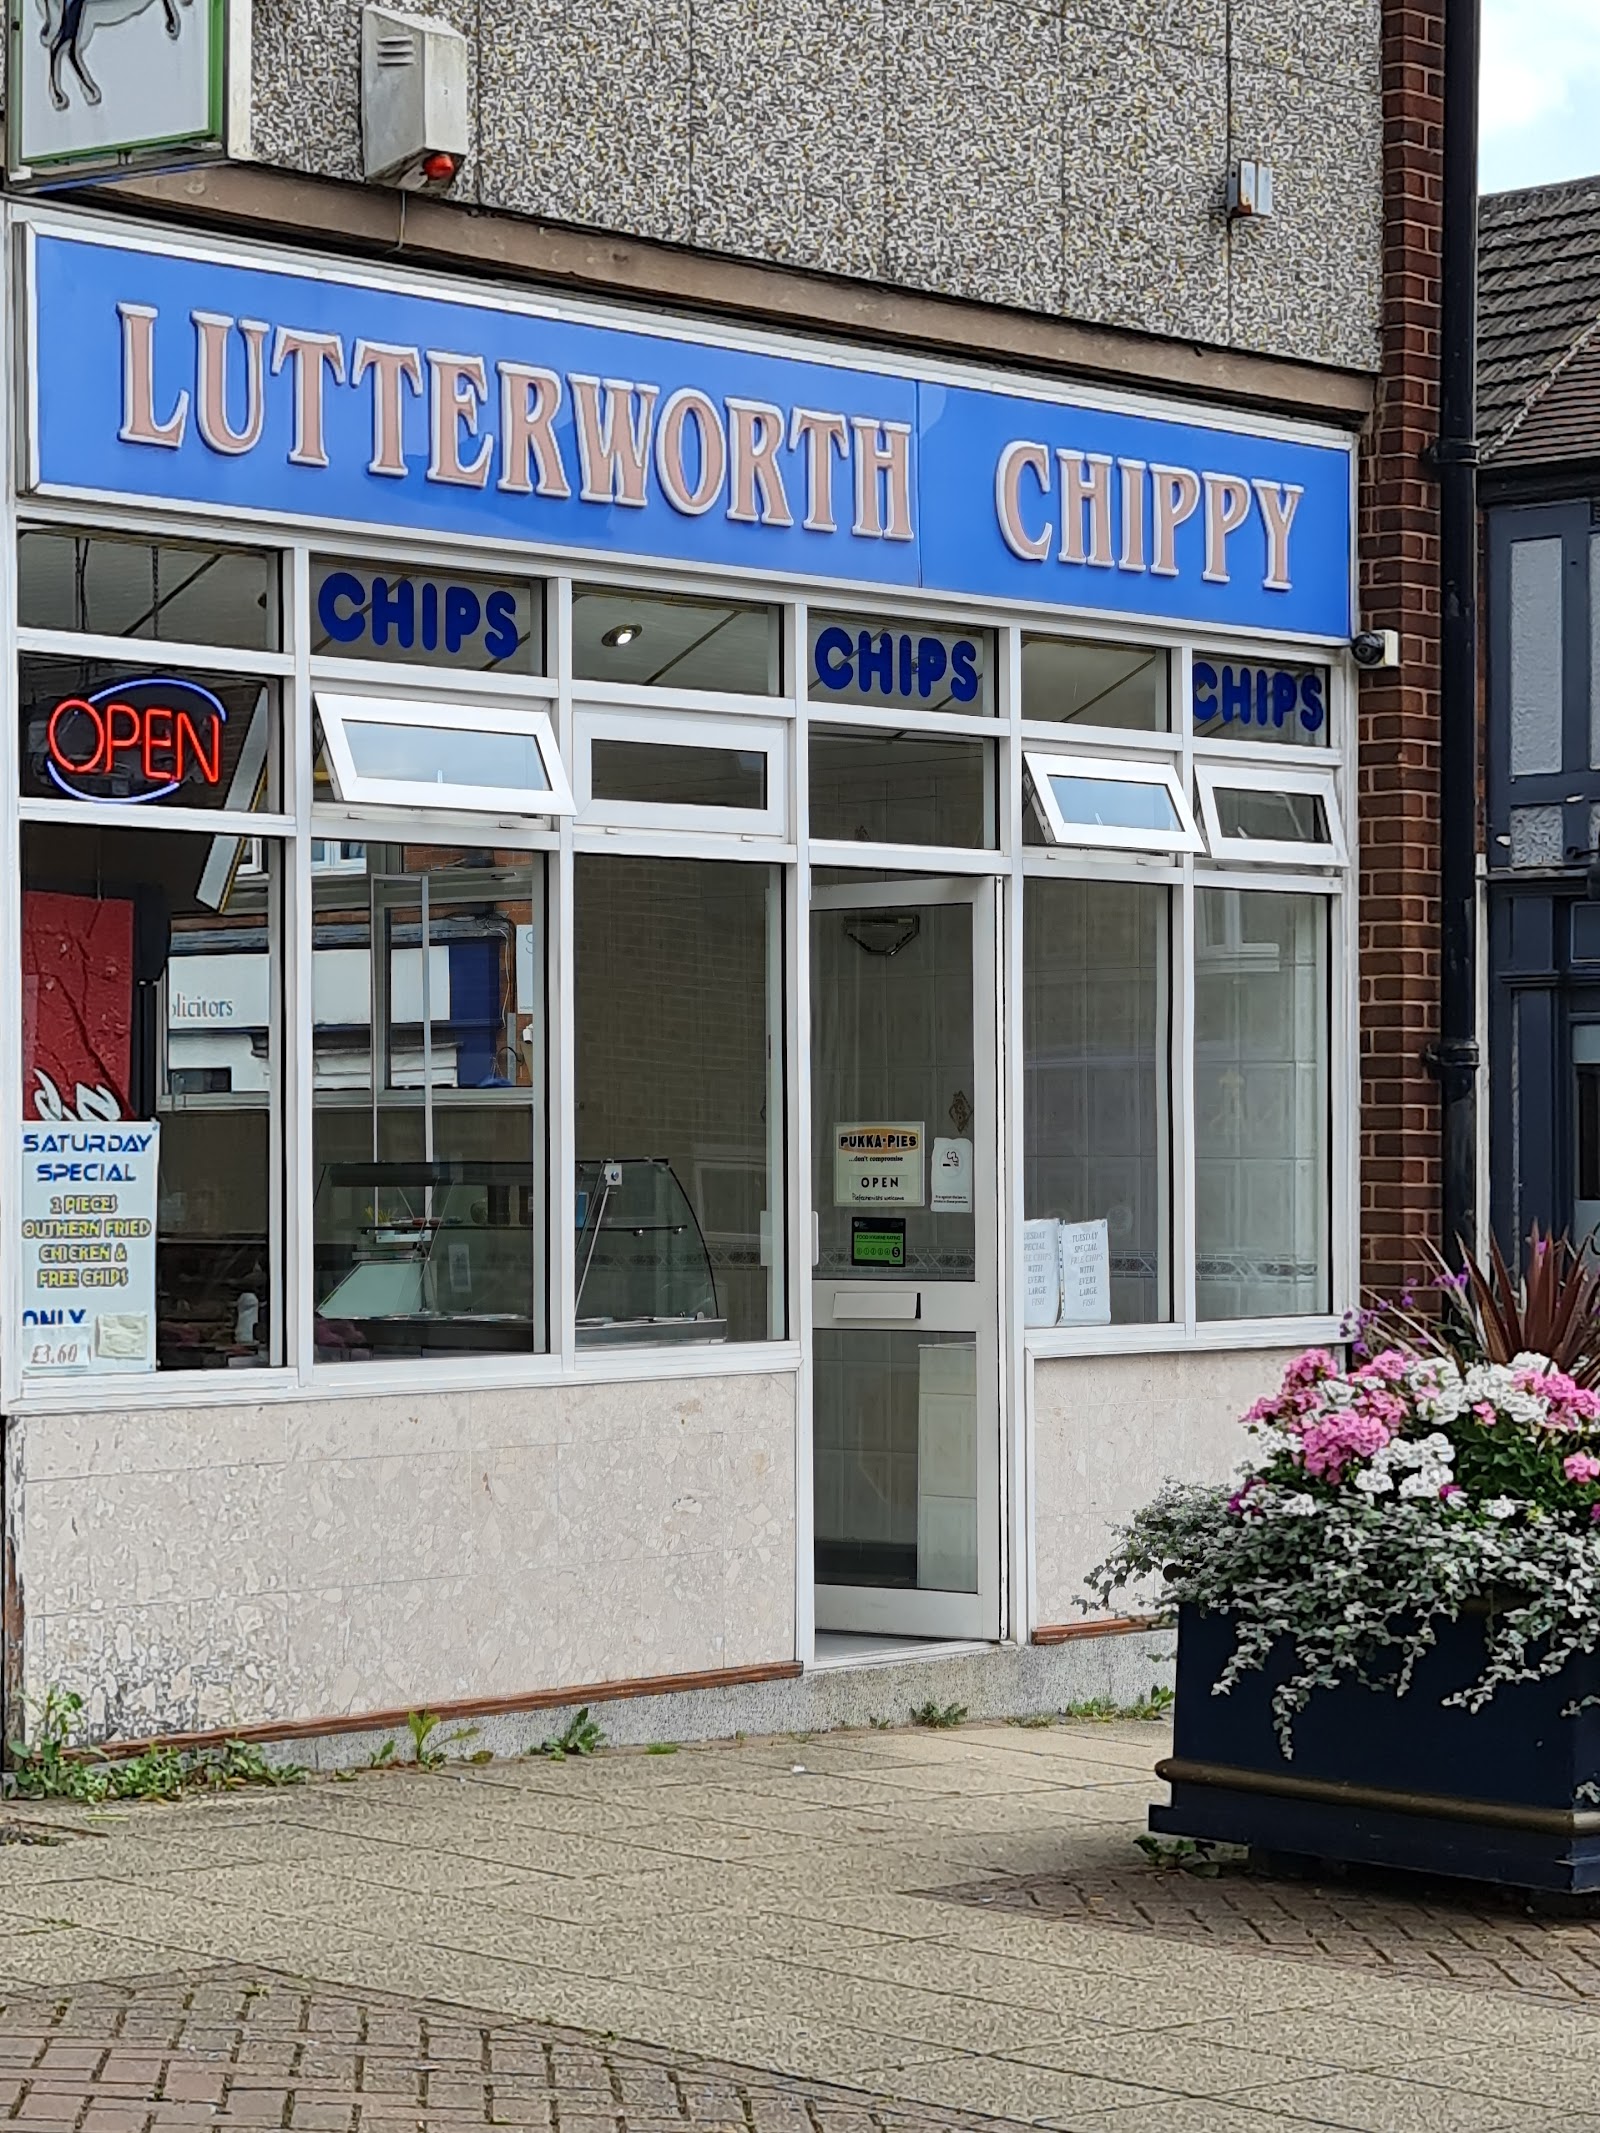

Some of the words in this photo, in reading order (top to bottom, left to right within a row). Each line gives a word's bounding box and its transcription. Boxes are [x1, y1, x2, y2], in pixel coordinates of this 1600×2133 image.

[117, 302, 915, 542] LUTTERWORTH
[996, 440, 1304, 592] CHIPPY
[319, 572, 519, 659] CHIPS
[814, 627, 978, 702] CHIPS
[1192, 662, 1323, 731] CHIPS
[49, 699, 220, 784] OPEN
[23, 1134, 152, 1152] SATURDAY
[869, 1155, 904, 1163] compromise
[37, 1163, 136, 1181] SPECIAL
[861, 1177, 899, 1188] OPEN
[64, 1193, 118, 1214] PIECES
[22, 1219, 102, 1239] OUTHERN
[104, 1218, 152, 1238] FRIED
[1024, 1231, 1047, 1240] UESDAY
[1072, 1232, 1098, 1243] TUESDAY
[1024, 1242, 1045, 1251] PECIAL
[1074, 1243, 1097, 1253] SPECIAL
[39, 1243, 112, 1263] CHICKEN
[114, 1243, 128, 1262] &
[1028, 1265, 1043, 1273] WITH
[1080, 1265, 1094, 1274] WITH
[37, 1268, 79, 1288] FREE
[81, 1267, 129, 1287] CHIPS
[1028, 1275, 1045, 1284] EVERY
[1079, 1276, 1096, 1285] EVERY
[1028, 1286, 1047, 1295] LARGE
[1080, 1287, 1098, 1296] LARGE
[1031, 1298, 1044, 1306] FISH
[1082, 1298, 1096, 1307] FISH
